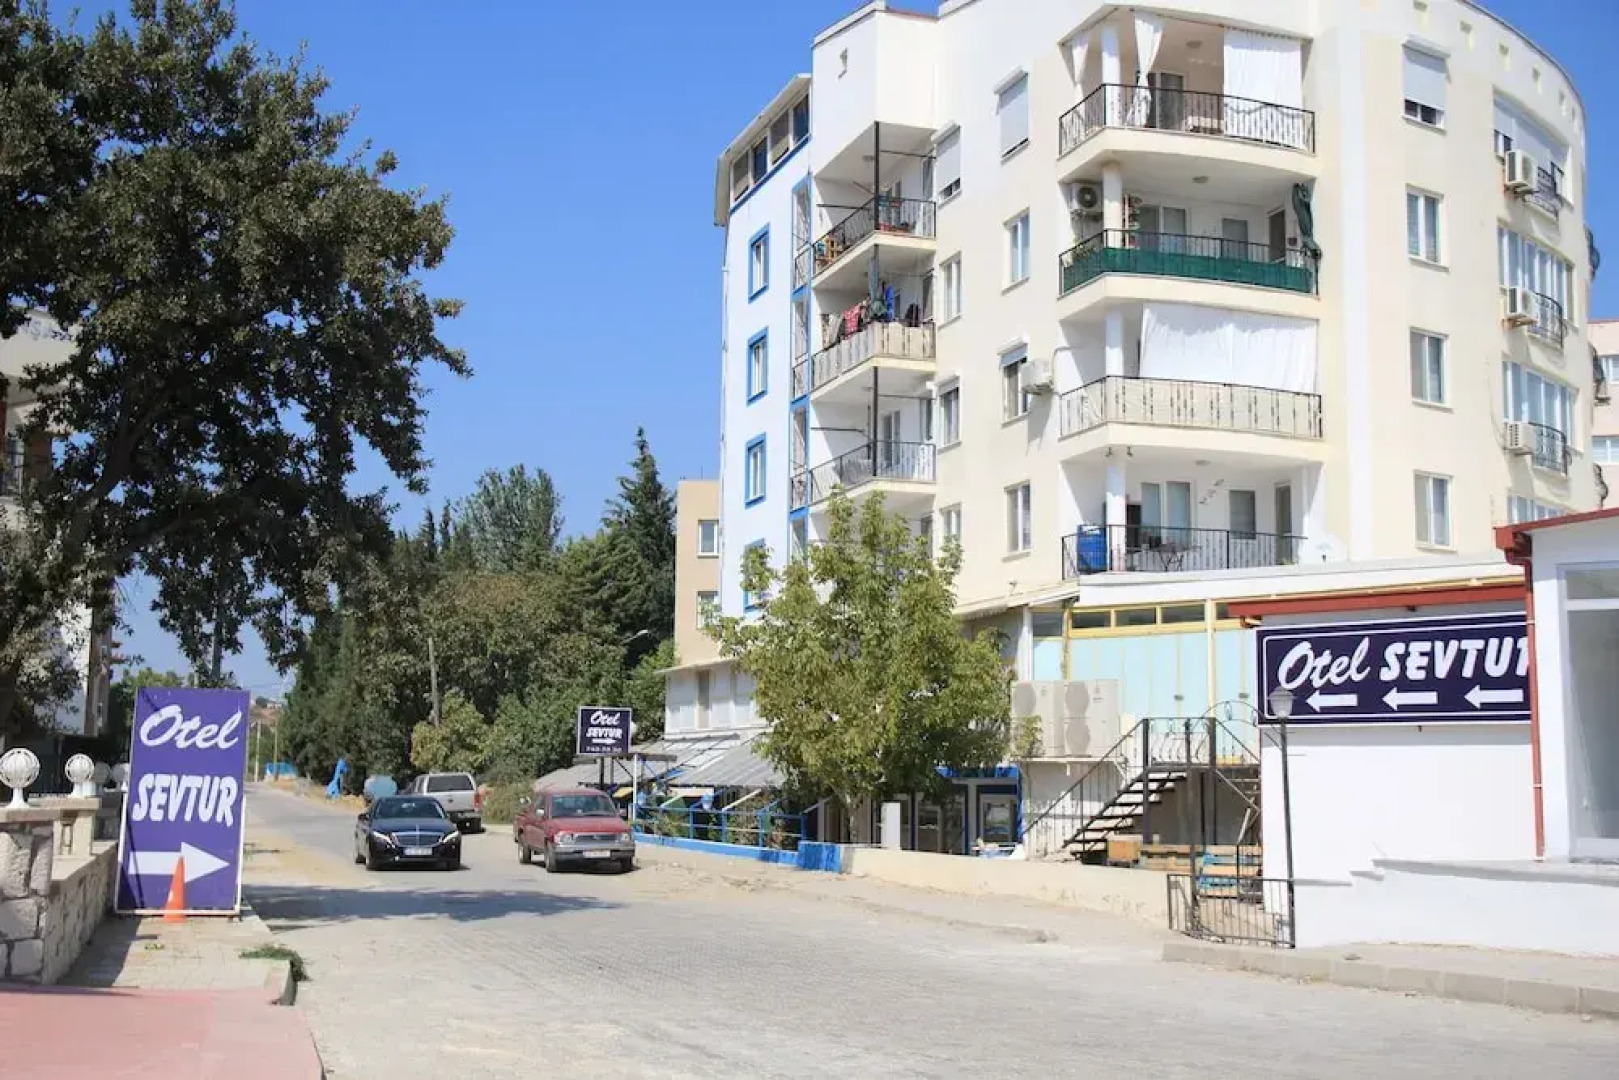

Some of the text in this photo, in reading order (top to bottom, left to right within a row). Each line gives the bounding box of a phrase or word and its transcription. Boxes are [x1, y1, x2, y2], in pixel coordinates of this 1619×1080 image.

[1278, 637, 1371, 690] Otel
[140, 704, 242, 749] Otel
[585, 727, 623, 739] SEVTUR
[590, 710, 621, 726] Otel
[132, 774, 238, 827] SEVTUR
